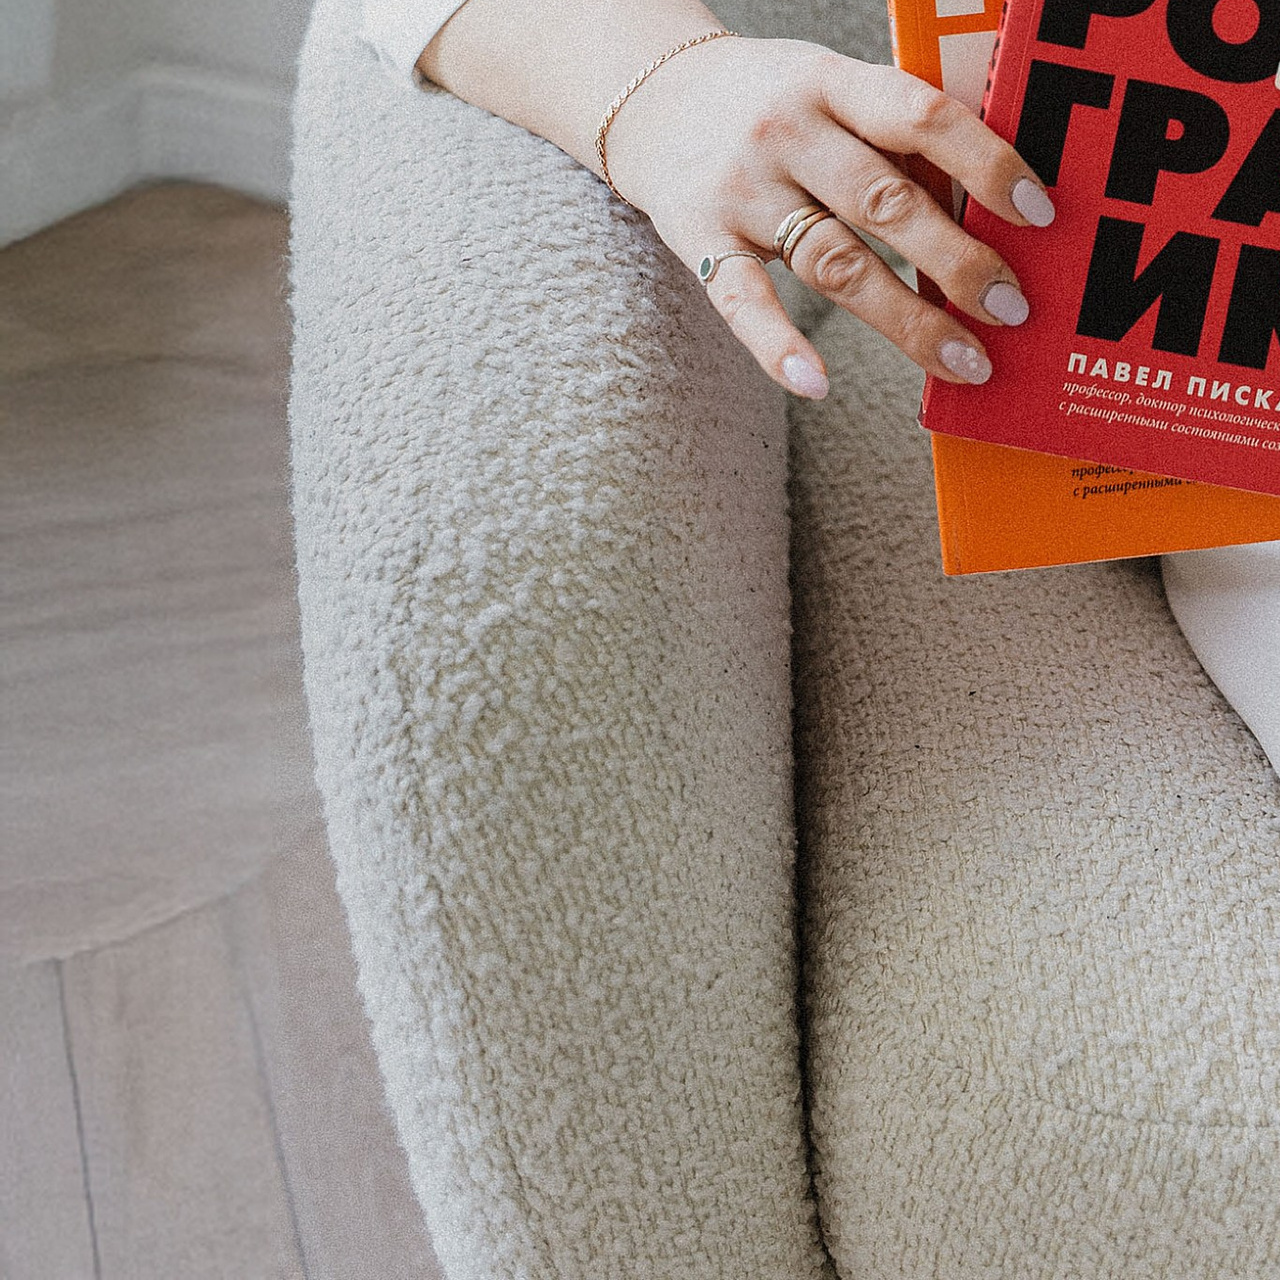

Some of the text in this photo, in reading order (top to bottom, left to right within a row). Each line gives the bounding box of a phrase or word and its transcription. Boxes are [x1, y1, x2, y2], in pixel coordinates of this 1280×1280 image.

[1067, 352, 1173, 391] ПАВЕЛ
[1063, 381, 1133, 407] профессор,
[1136, 392, 1187, 417] доктор
[1059, 400, 1066, 411] с
[1067, 402, 1169, 431] расширенными
[1171, 422, 1260, 448] состояниями
[1073, 487, 1080, 497] с
